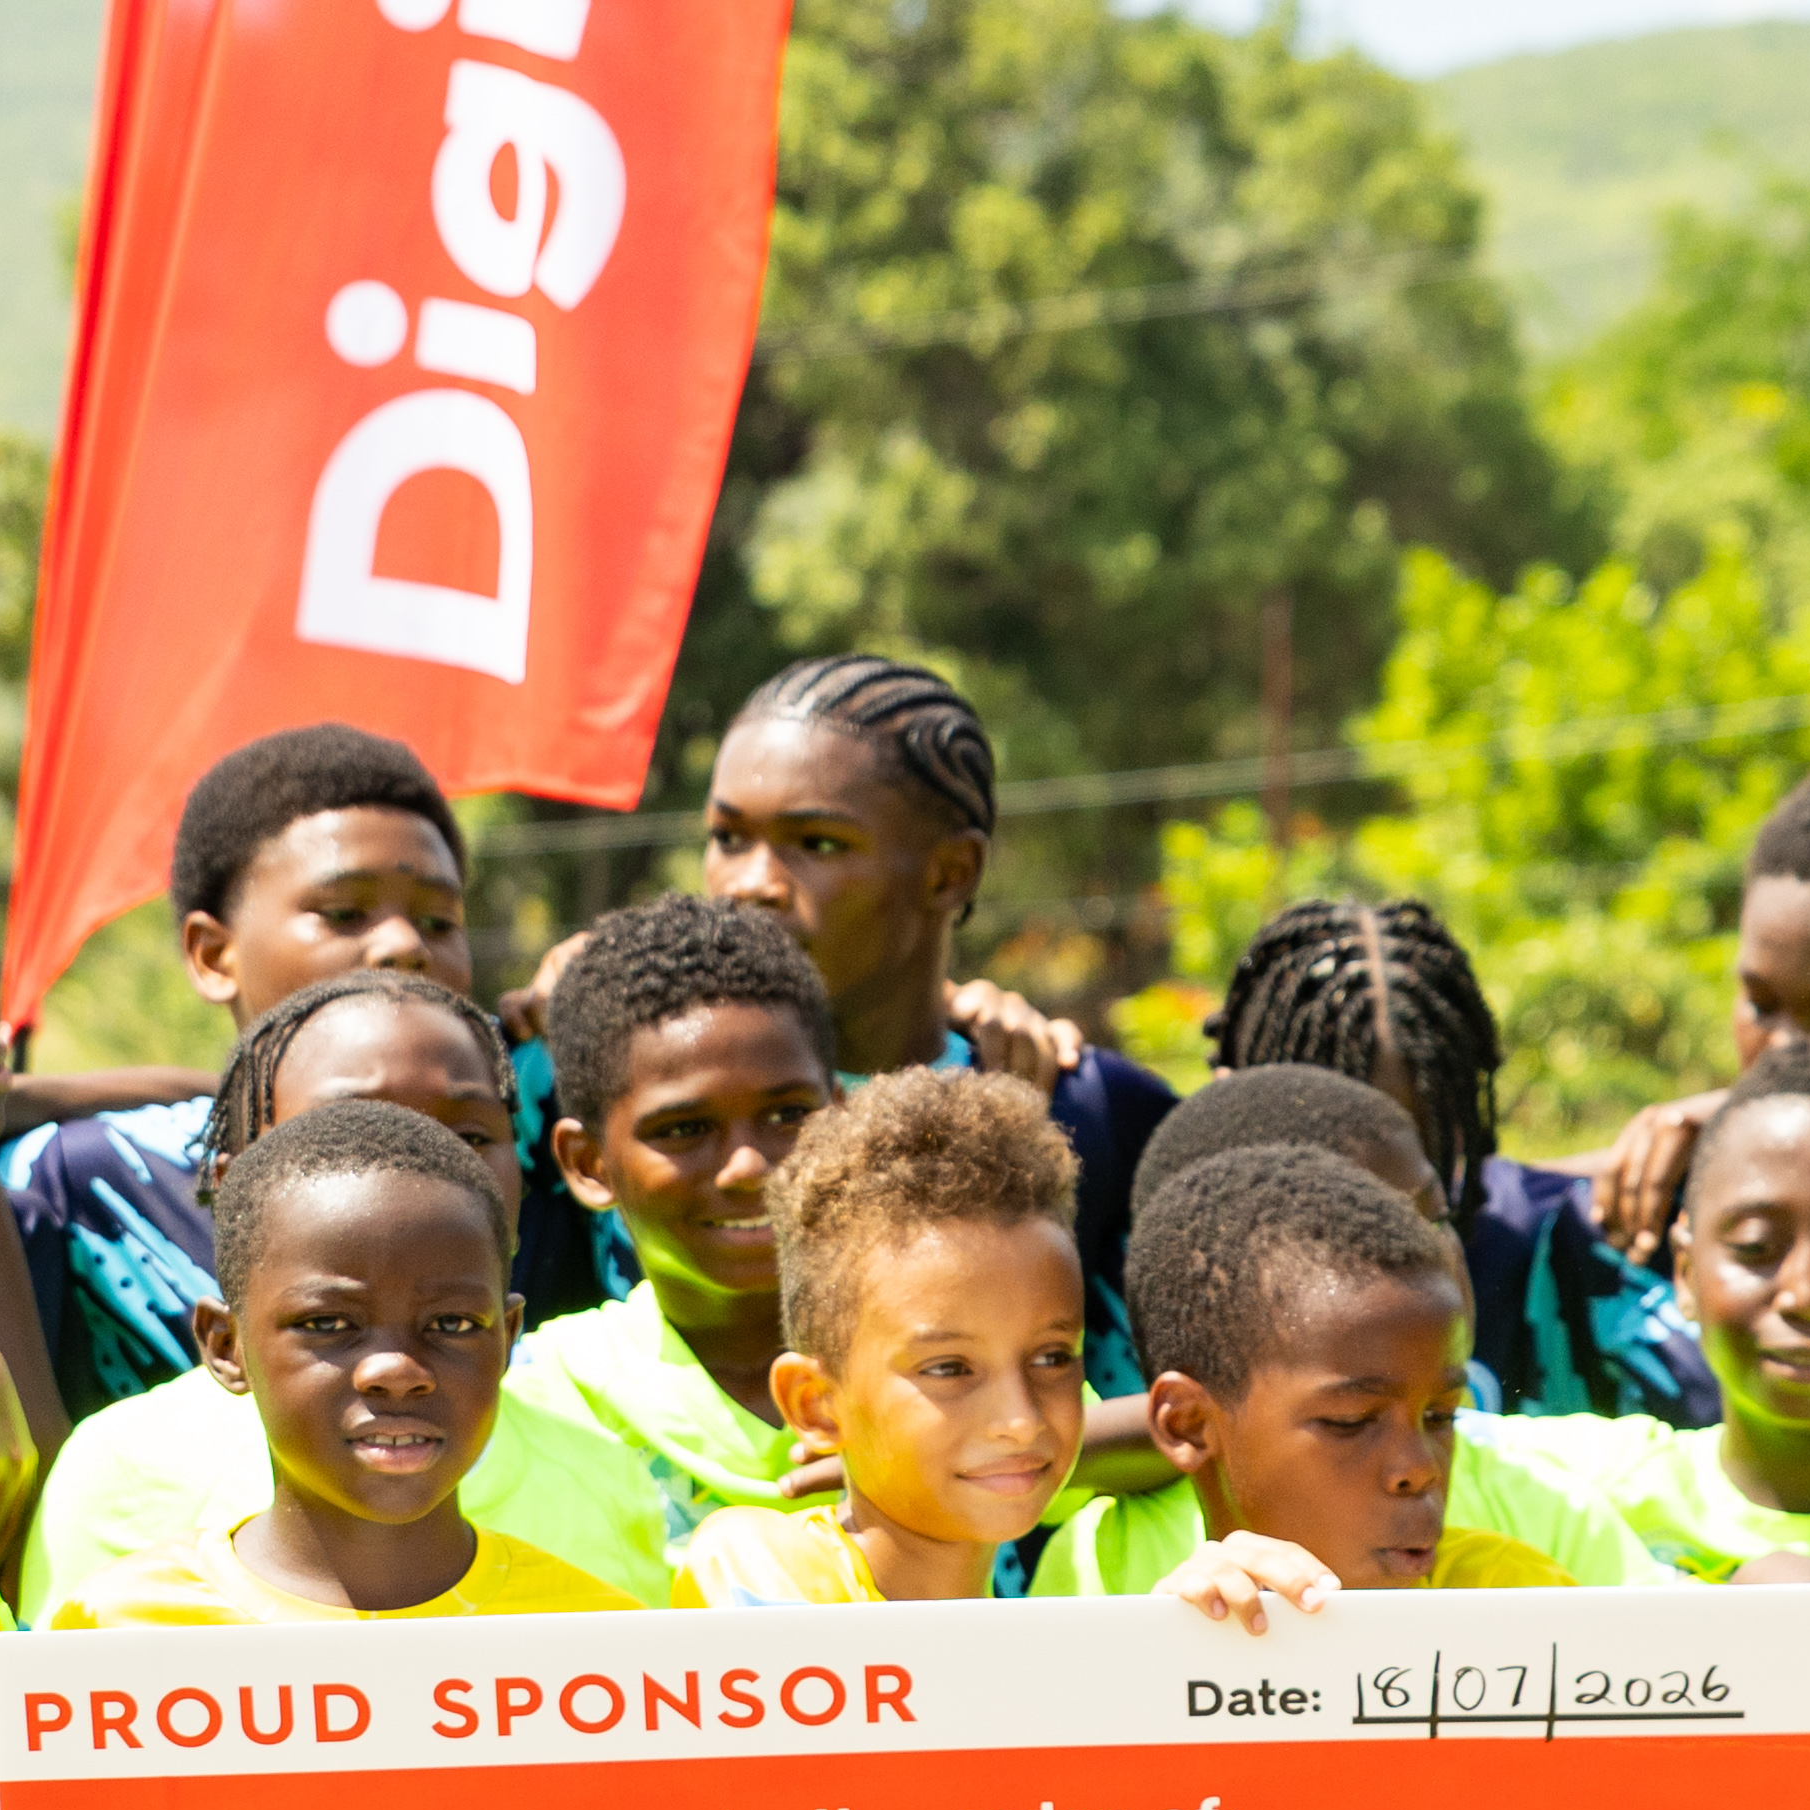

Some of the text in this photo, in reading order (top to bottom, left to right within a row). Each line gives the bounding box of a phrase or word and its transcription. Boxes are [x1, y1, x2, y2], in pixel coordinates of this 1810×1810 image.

[23, 1663, 919, 1753] PROUD SPONSOR
[1187, 1677, 1322, 1718] Date:
